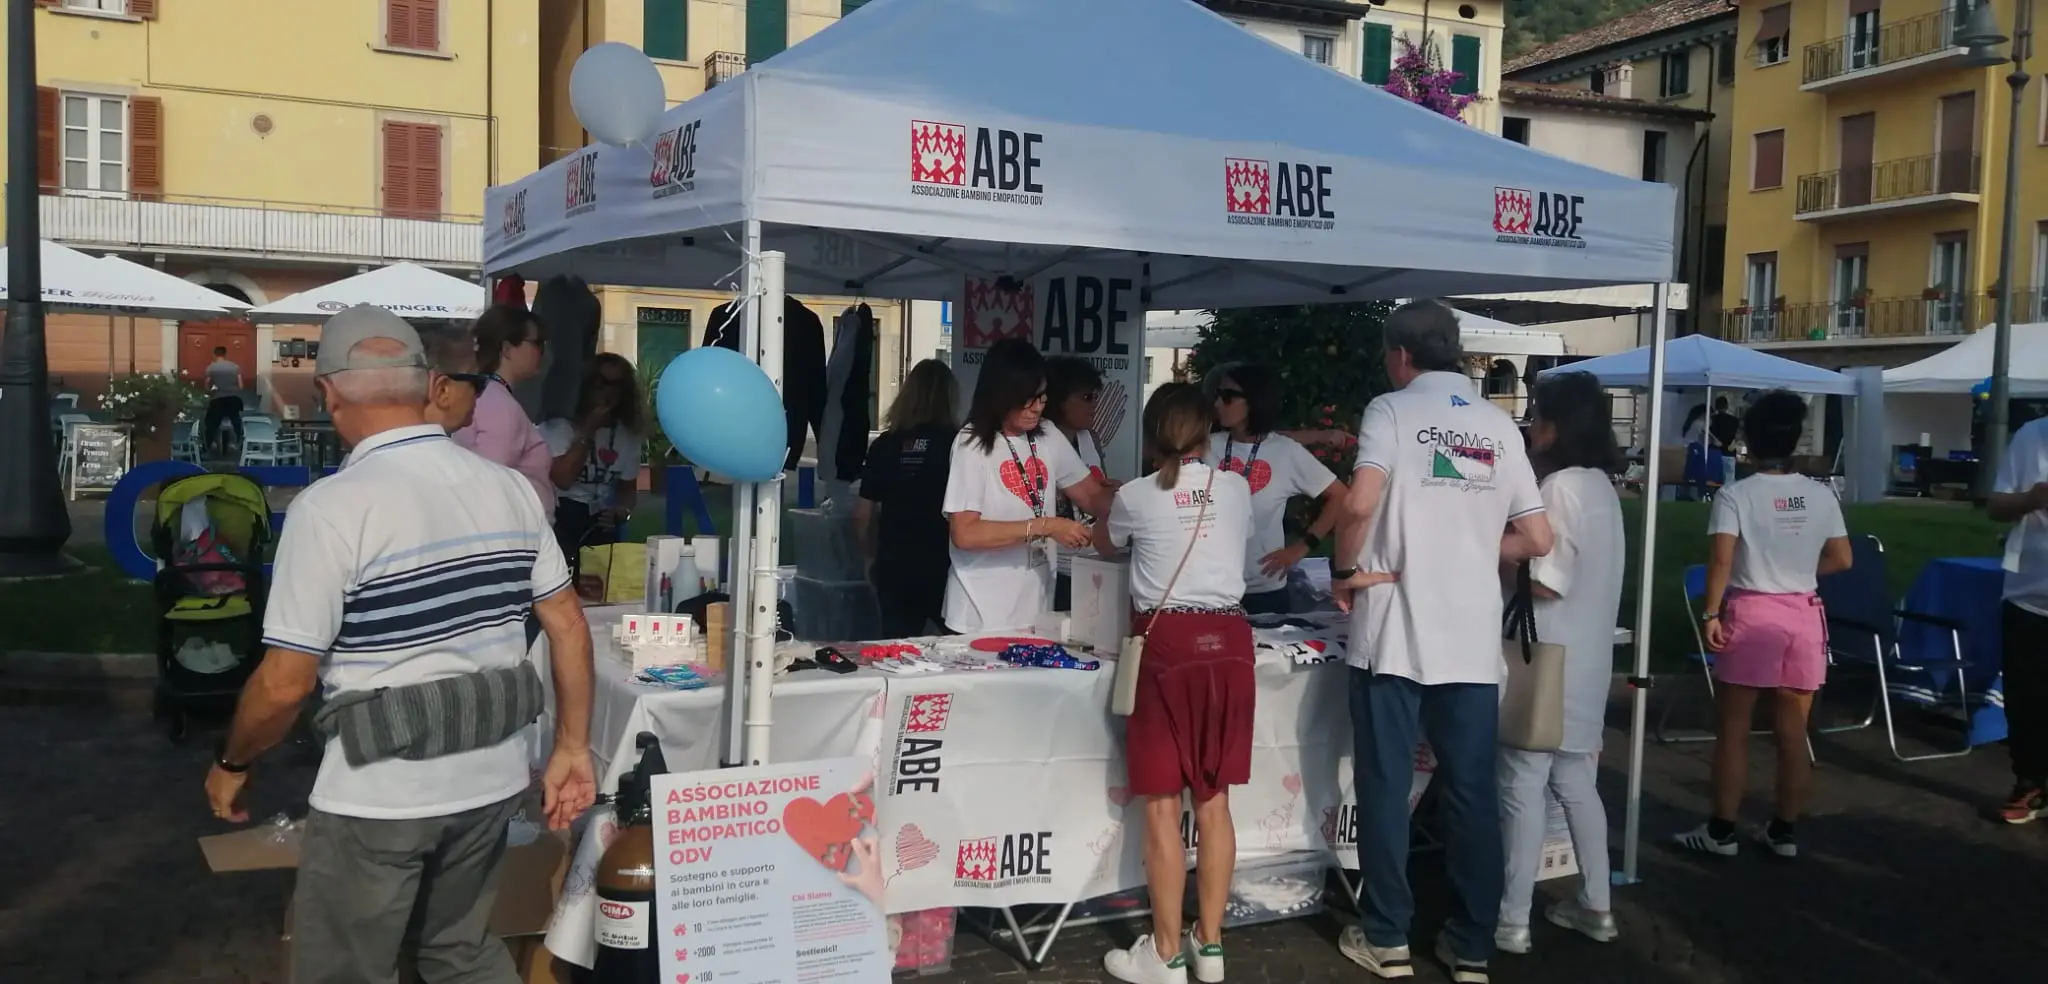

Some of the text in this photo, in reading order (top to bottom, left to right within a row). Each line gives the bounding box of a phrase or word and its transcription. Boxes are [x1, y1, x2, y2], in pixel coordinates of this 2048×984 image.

[669, 119, 701, 185] ABE
[972, 127, 1043, 193] ABE
[579, 152, 598, 204] ABE
[1276, 161, 1335, 219] ABE
[911, 185, 1043, 206] ASSOCIAZIONE BAMBINO EMOPATICO ODV
[1533, 192, 1585, 240] ABE
[1041, 276, 1132, 355] ABE
[1788, 496, 1806, 509] ABE
[896, 738, 943, 795] ABE
[666, 775, 821, 805] ASSOCIAZIONE
[667, 800, 768, 825] BAMBINO
[1337, 804, 1358, 843] AB
[668, 818, 781, 846] EMOPATICO
[669, 846, 713, 865] ODV
[1000, 832, 1053, 879] ABE
[670, 870, 718, 883] Sostegno
[730, 863, 776, 877] supporto
[671, 887, 680, 897] ai
[682, 882, 724, 896] bambini
[727, 881, 736, 890] in
[739, 879, 760, 889] cura
[601, 904, 630, 917] CIMA
[671, 900, 690, 911] alle
[692, 897, 713, 908] loro
[693, 922, 702, 933] 10
[693, 945, 716, 958] +2000
